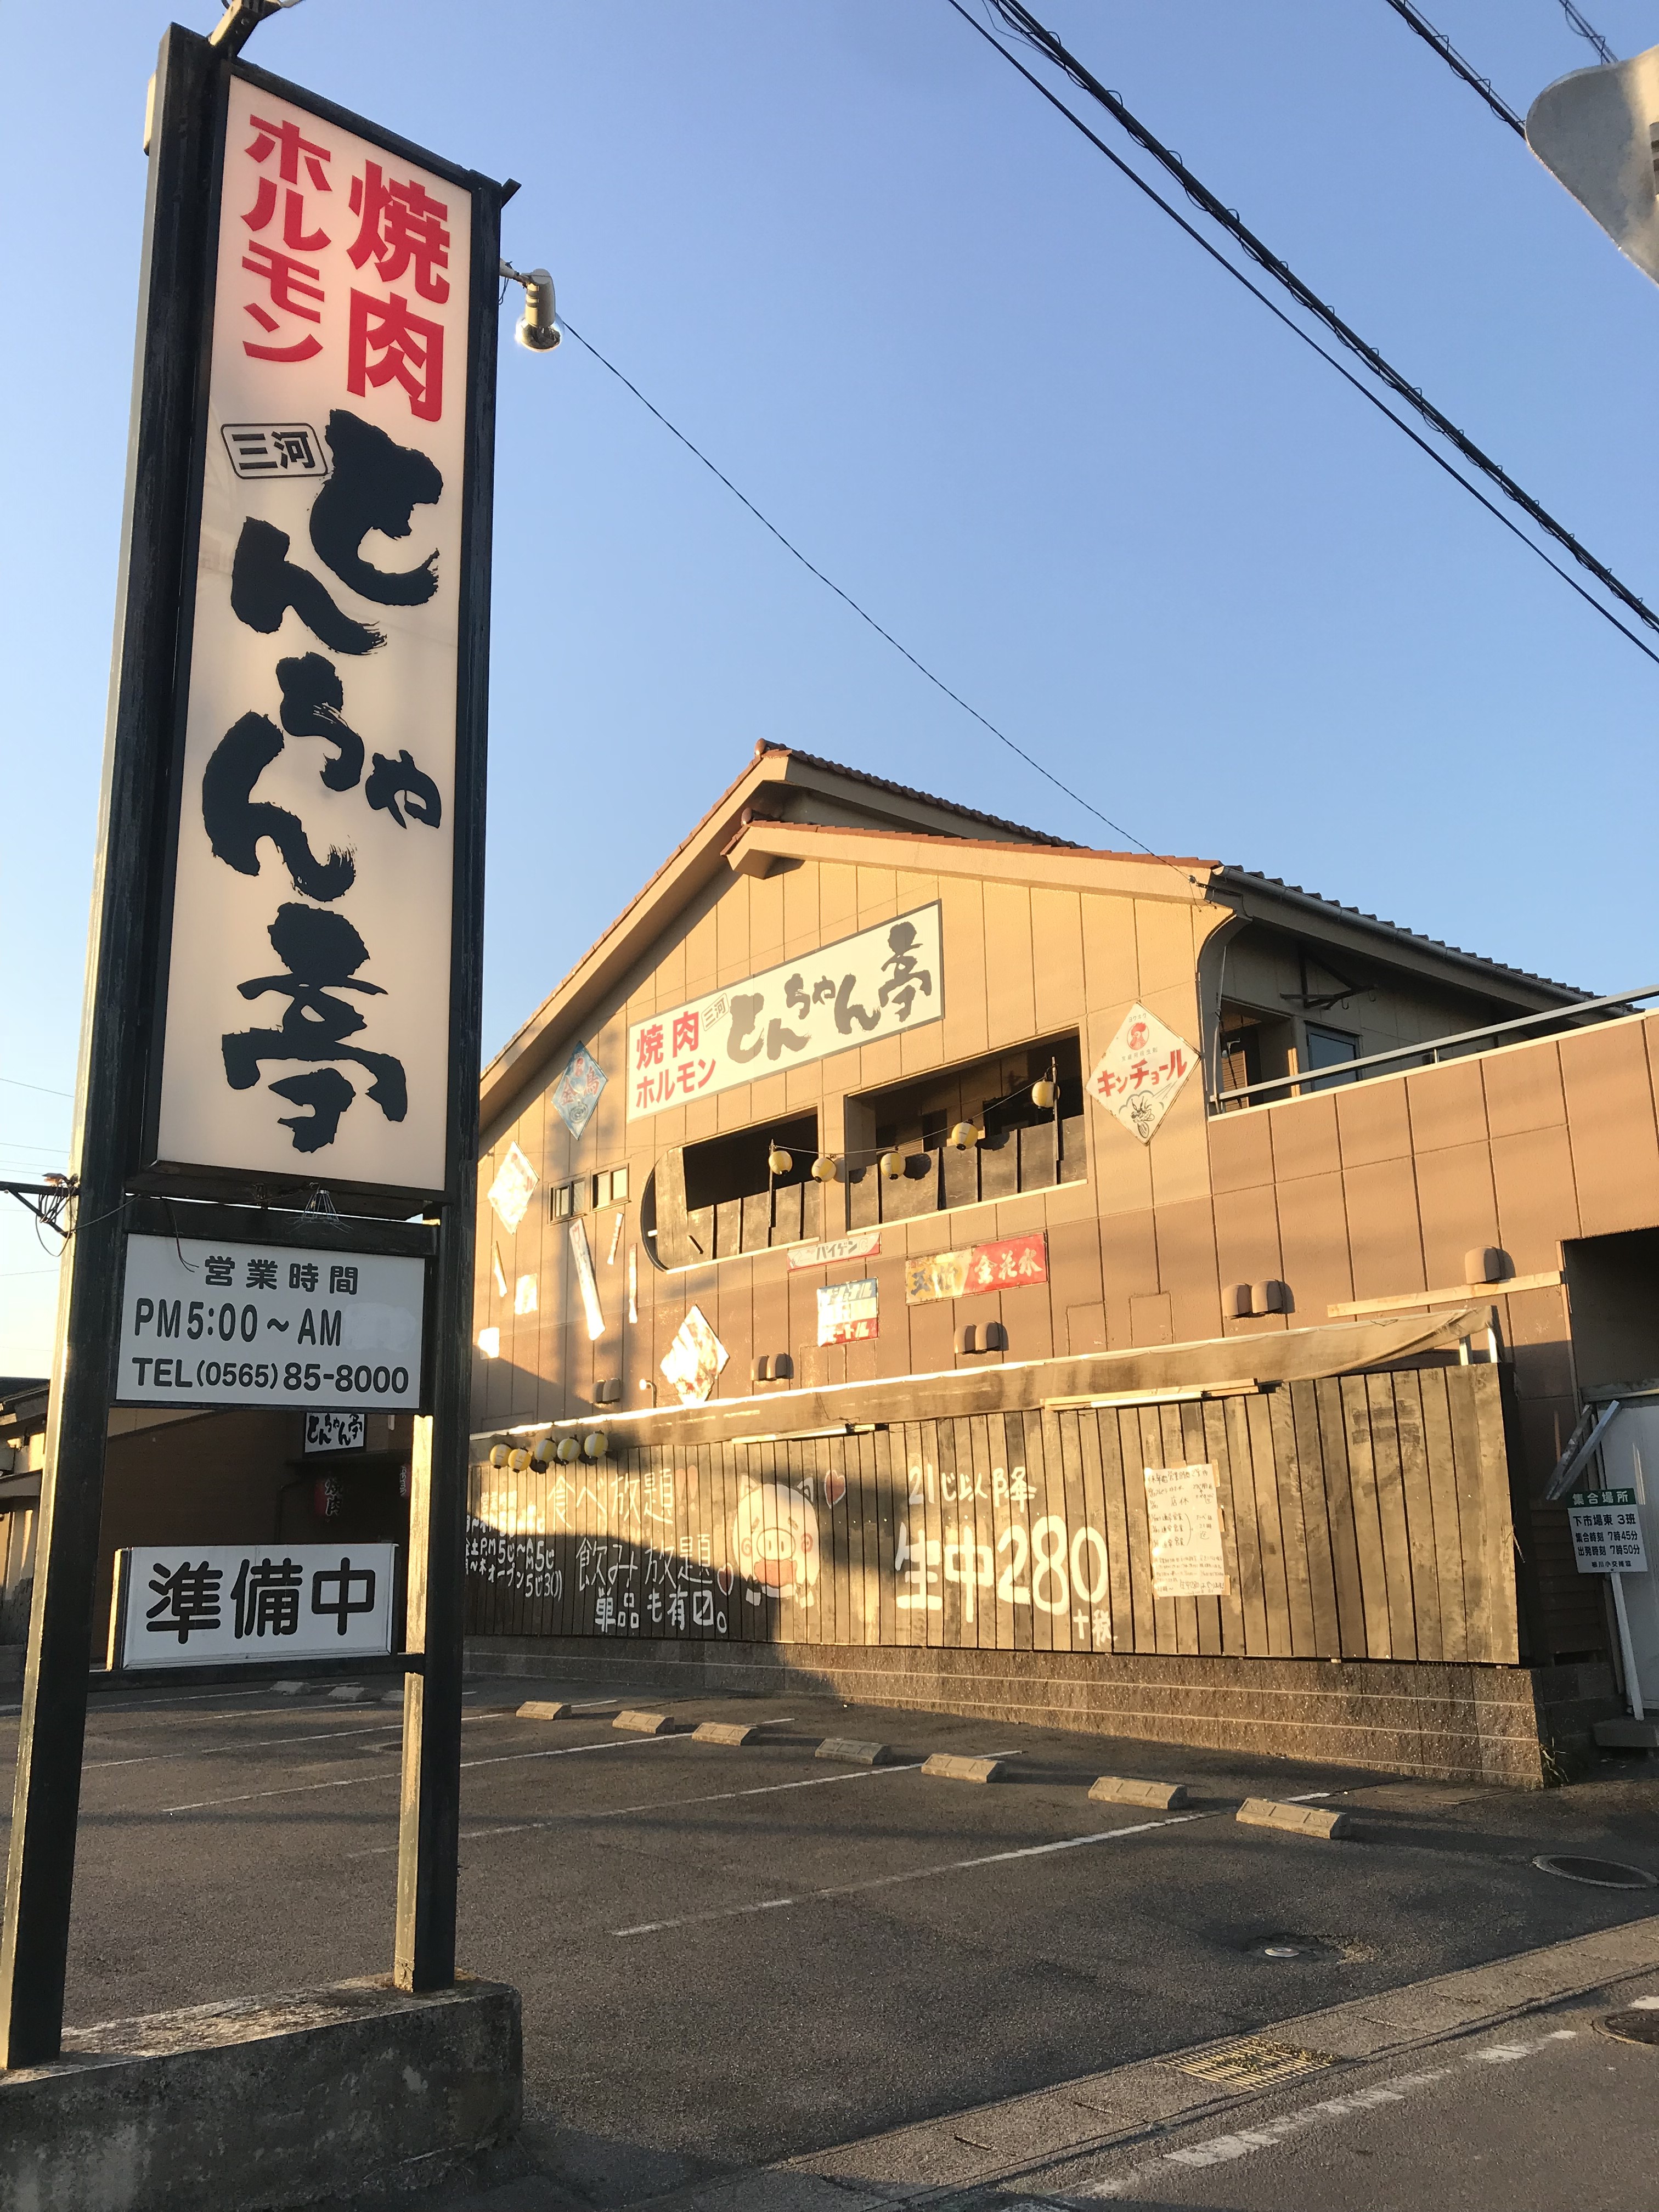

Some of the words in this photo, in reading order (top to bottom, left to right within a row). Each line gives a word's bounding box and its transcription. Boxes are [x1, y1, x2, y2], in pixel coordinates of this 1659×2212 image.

[241, 114, 332, 363] ホルモン
[347, 159, 450, 422] 焼肉
[232, 431, 316, 471] 三河
[202, 408, 443, 1154] とんちゃん亭
[704, 997, 726, 1024] 三河
[727, 921, 932, 1064] とんちゃん亭
[1128, 1013, 1147, 1023] ヨクキク
[636, 1011, 699, 1072] 焼肉
[558, 1065, 601, 1107] 金鳥
[636, 1058, 716, 1109] ホルモン
[1097, 1048, 1188, 1098] キンチョール
[204, 1255, 358, 1295] 営業時間
[132, 1357, 409, 1393] TEL(0565)85-8000
[307, 1414, 363, 1445] とんちゃん亭
[909, 1463, 1037, 1513] 21じ以降
[1572, 1491, 1628, 1505] 集合場所
[1573, 1514, 1613, 1527] 下市場東
[1617, 1513, 1637, 1525] 3班
[1576, 1532, 1604, 1543] 集合時刻
[1607, 1530, 1638, 1541] 7時45分
[576, 1534, 713, 1592] 飲み放題
[895, 1515, 1108, 1623] 生中280
[1577, 1545, 1606, 1556] 出発時刻
[1610, 1544, 1640, 1555] 7時50分
[145, 1556, 376, 1645] 準備中
